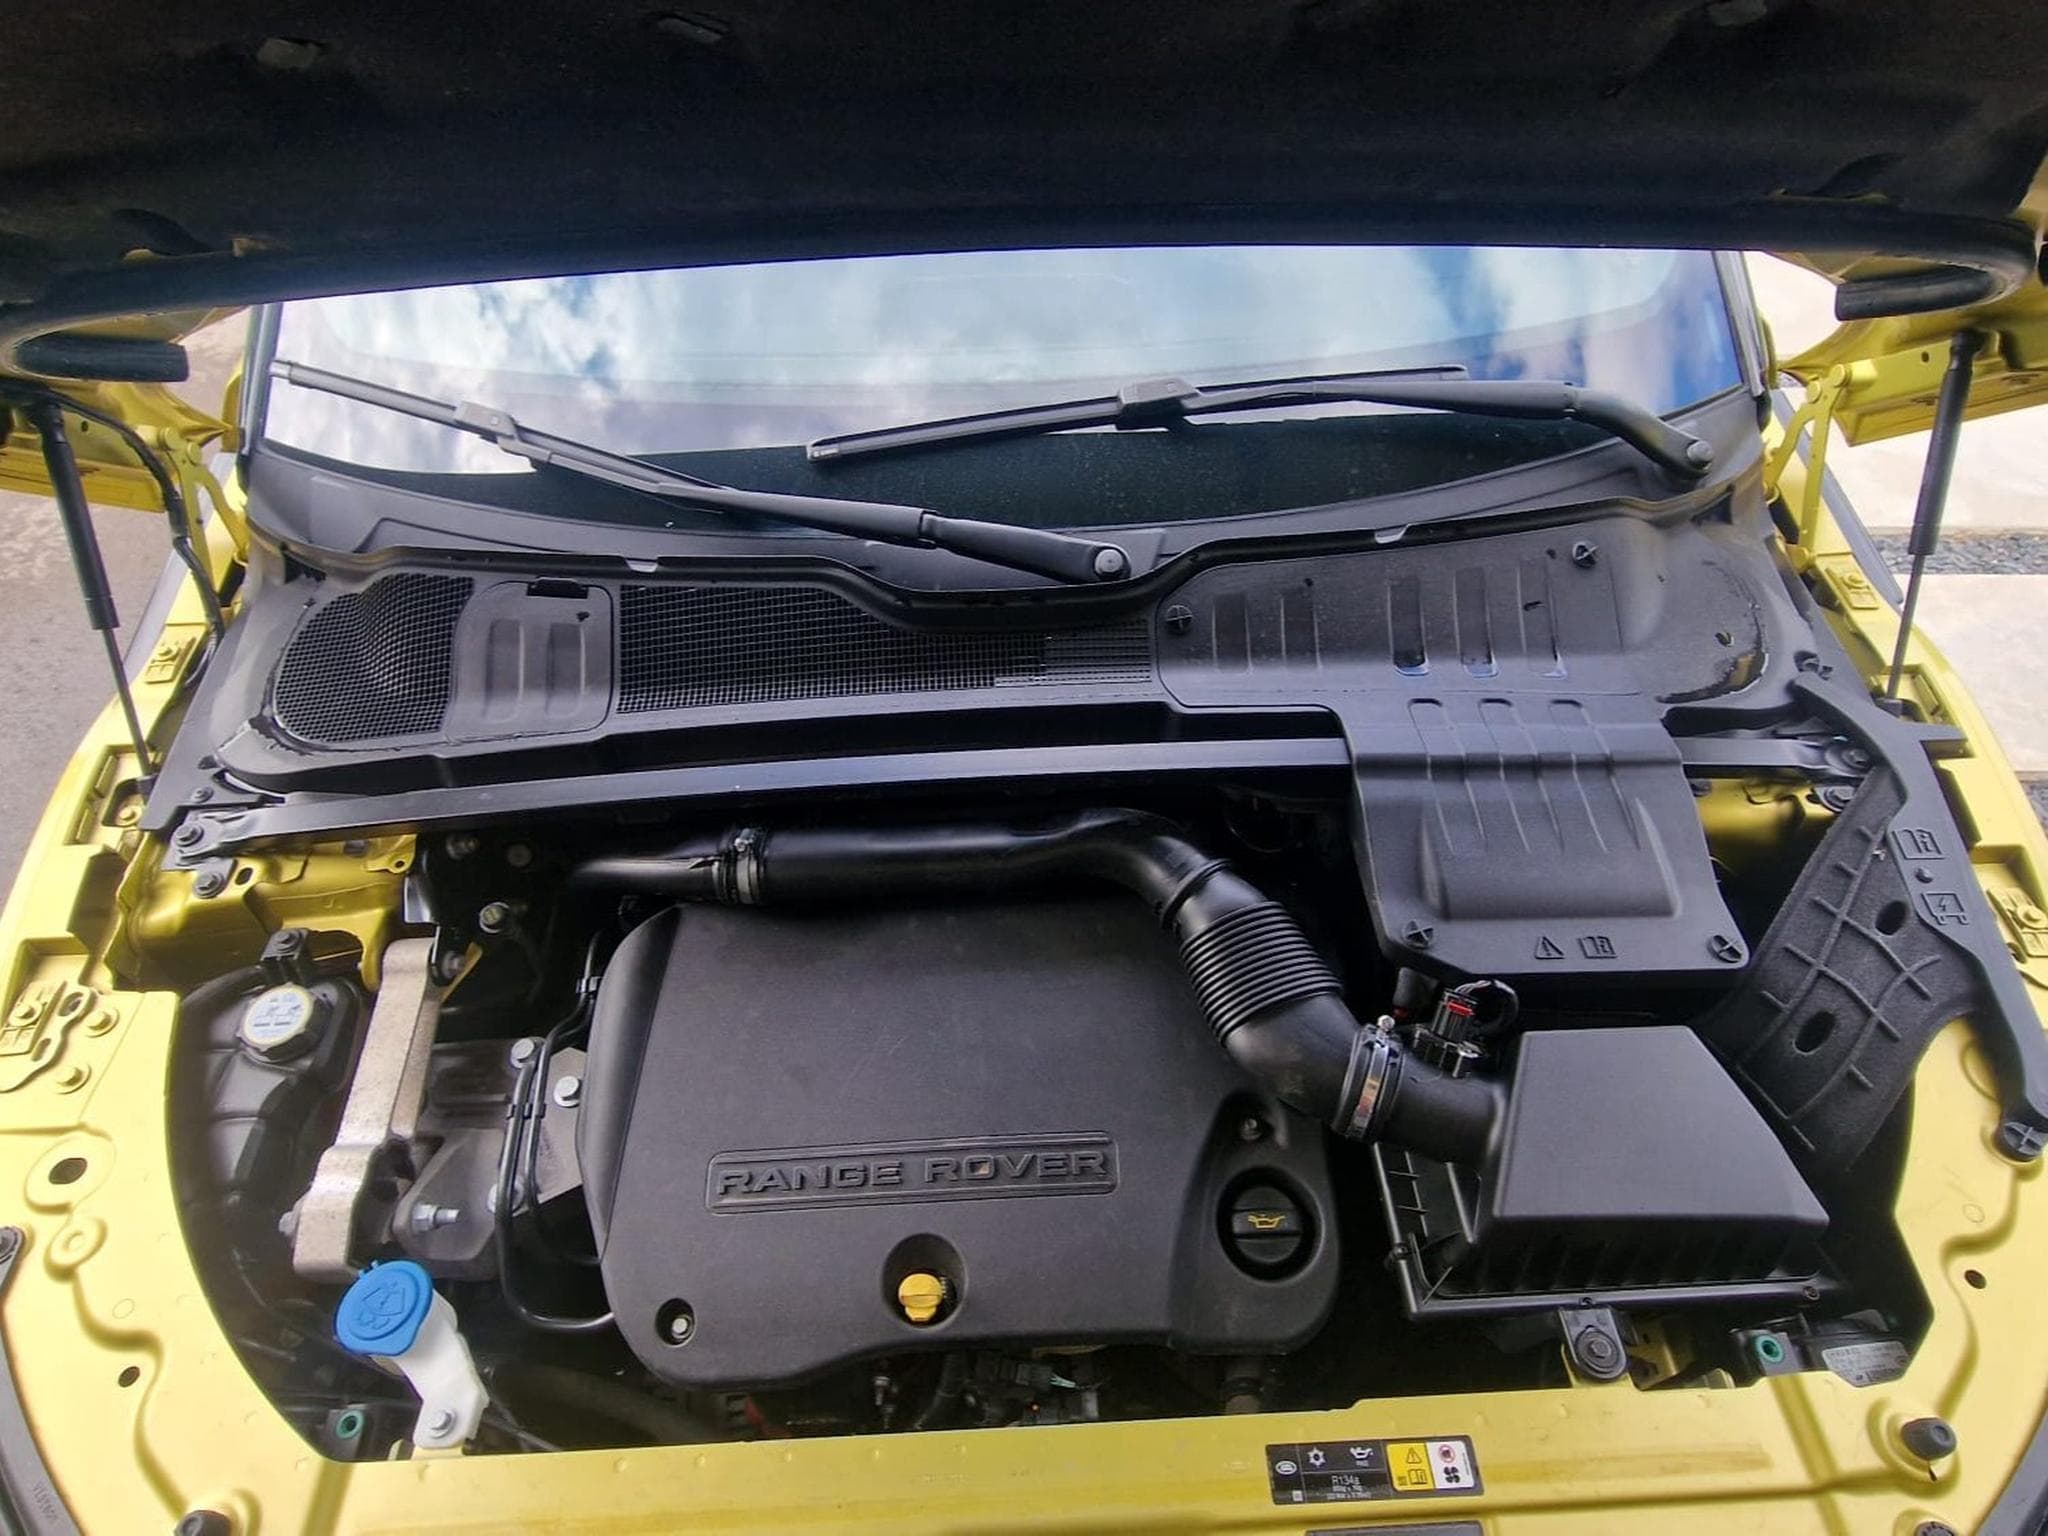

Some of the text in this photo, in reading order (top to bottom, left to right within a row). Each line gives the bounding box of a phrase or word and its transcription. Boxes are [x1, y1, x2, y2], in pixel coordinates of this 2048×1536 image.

[716, 1150, 1108, 1195] RANGE ROVER
[1331, 1475, 1360, 1486] R134a
